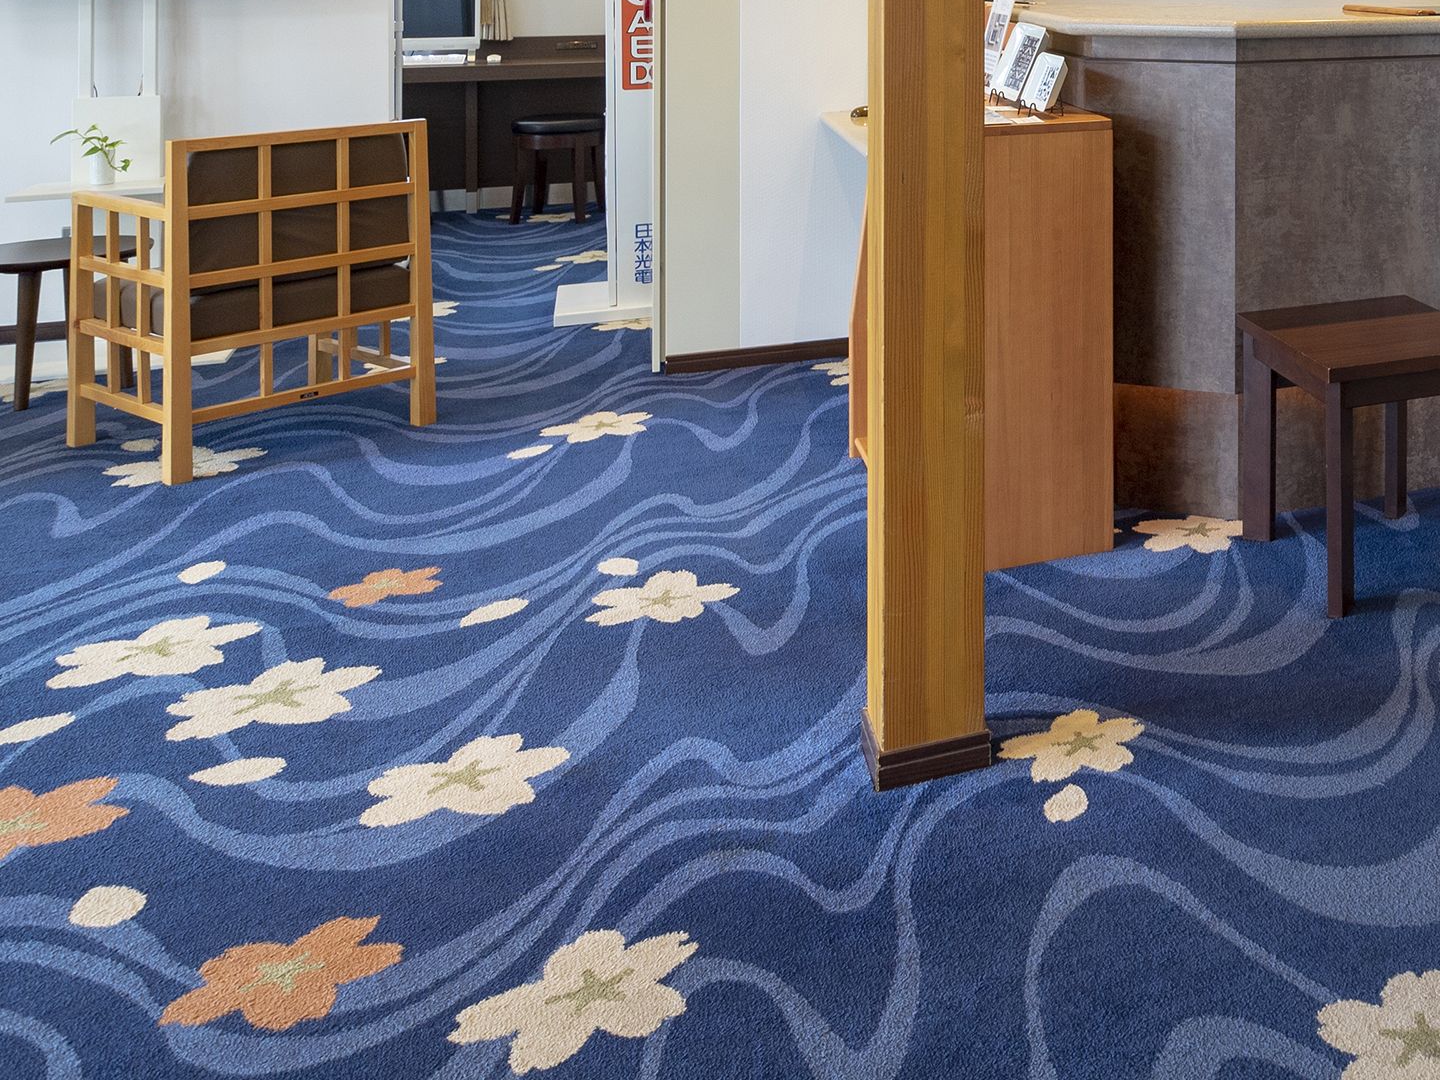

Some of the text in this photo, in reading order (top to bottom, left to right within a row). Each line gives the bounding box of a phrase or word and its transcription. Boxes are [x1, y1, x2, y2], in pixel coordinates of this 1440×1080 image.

[627, 9, 653, 85] AED
[634, 223, 652, 285] 日本光電
